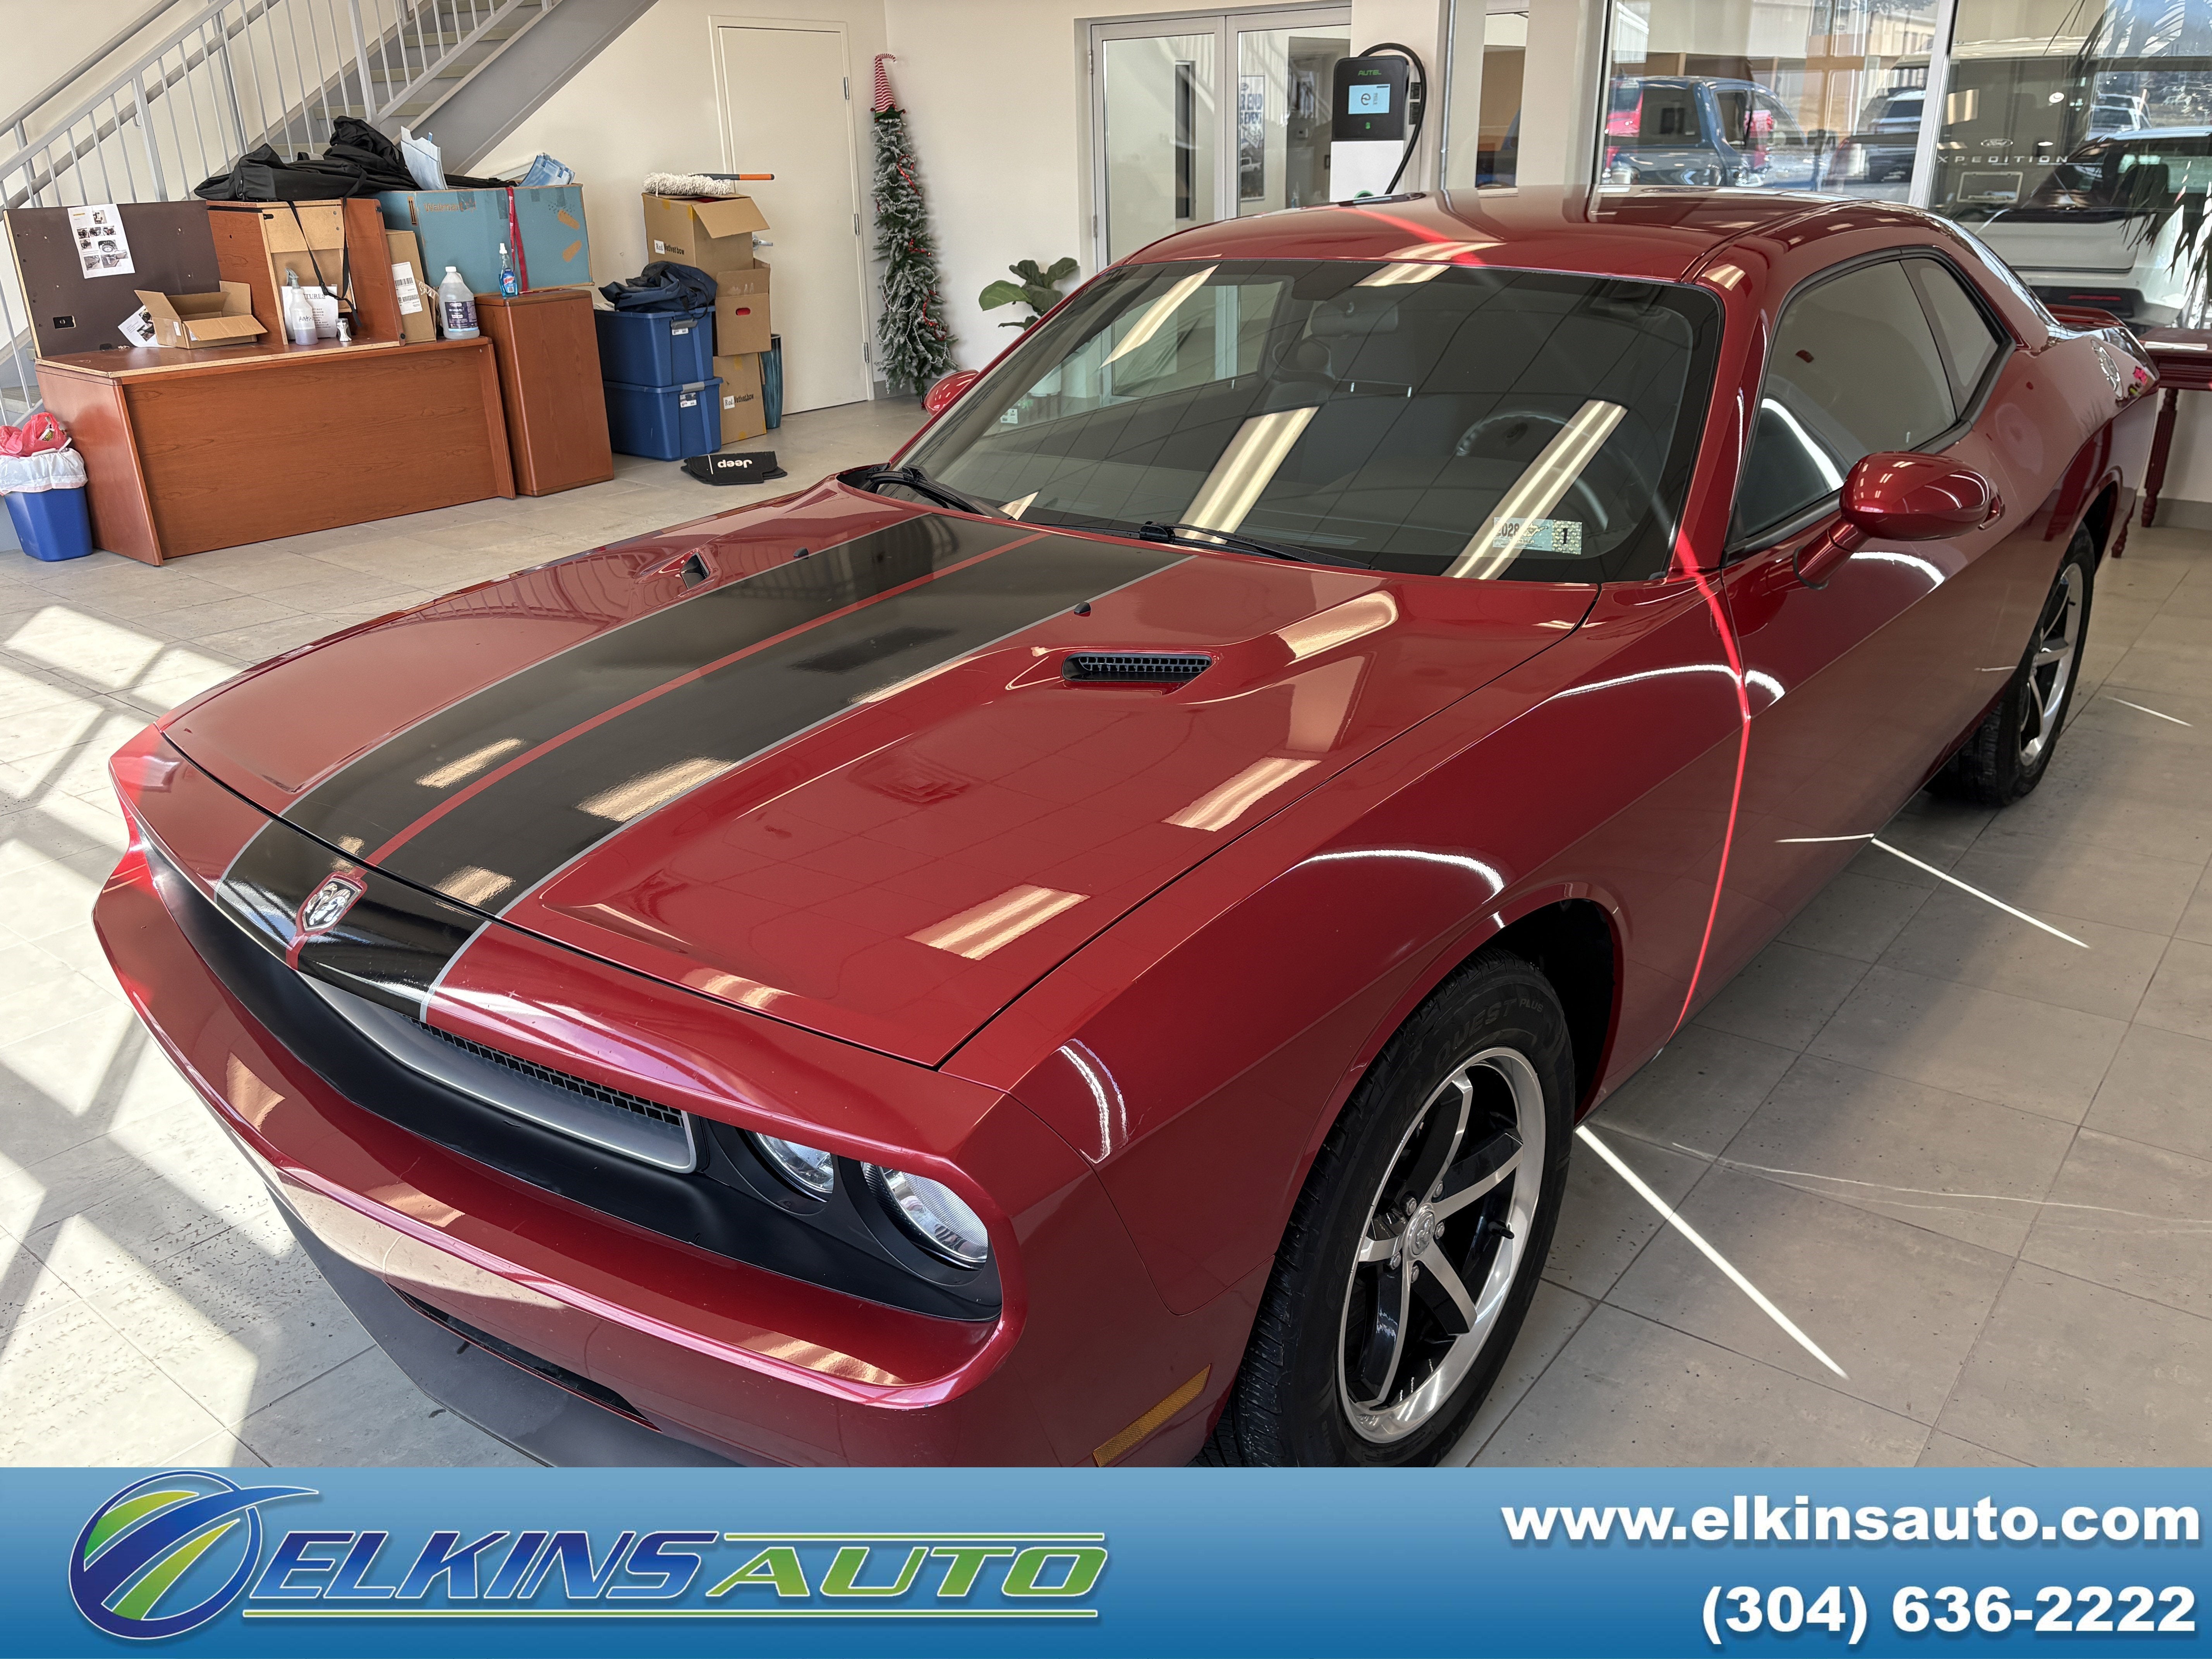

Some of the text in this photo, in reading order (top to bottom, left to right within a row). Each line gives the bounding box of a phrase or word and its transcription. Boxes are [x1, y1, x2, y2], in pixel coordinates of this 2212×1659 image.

[423, 201, 464, 213] Walmart
[717, 459, 752, 468] Jeep
[1563, 527, 1568, 544] 1
[1435, 998, 1517, 1072] QUEST
[1519, 998, 1544, 1013] PLUS
